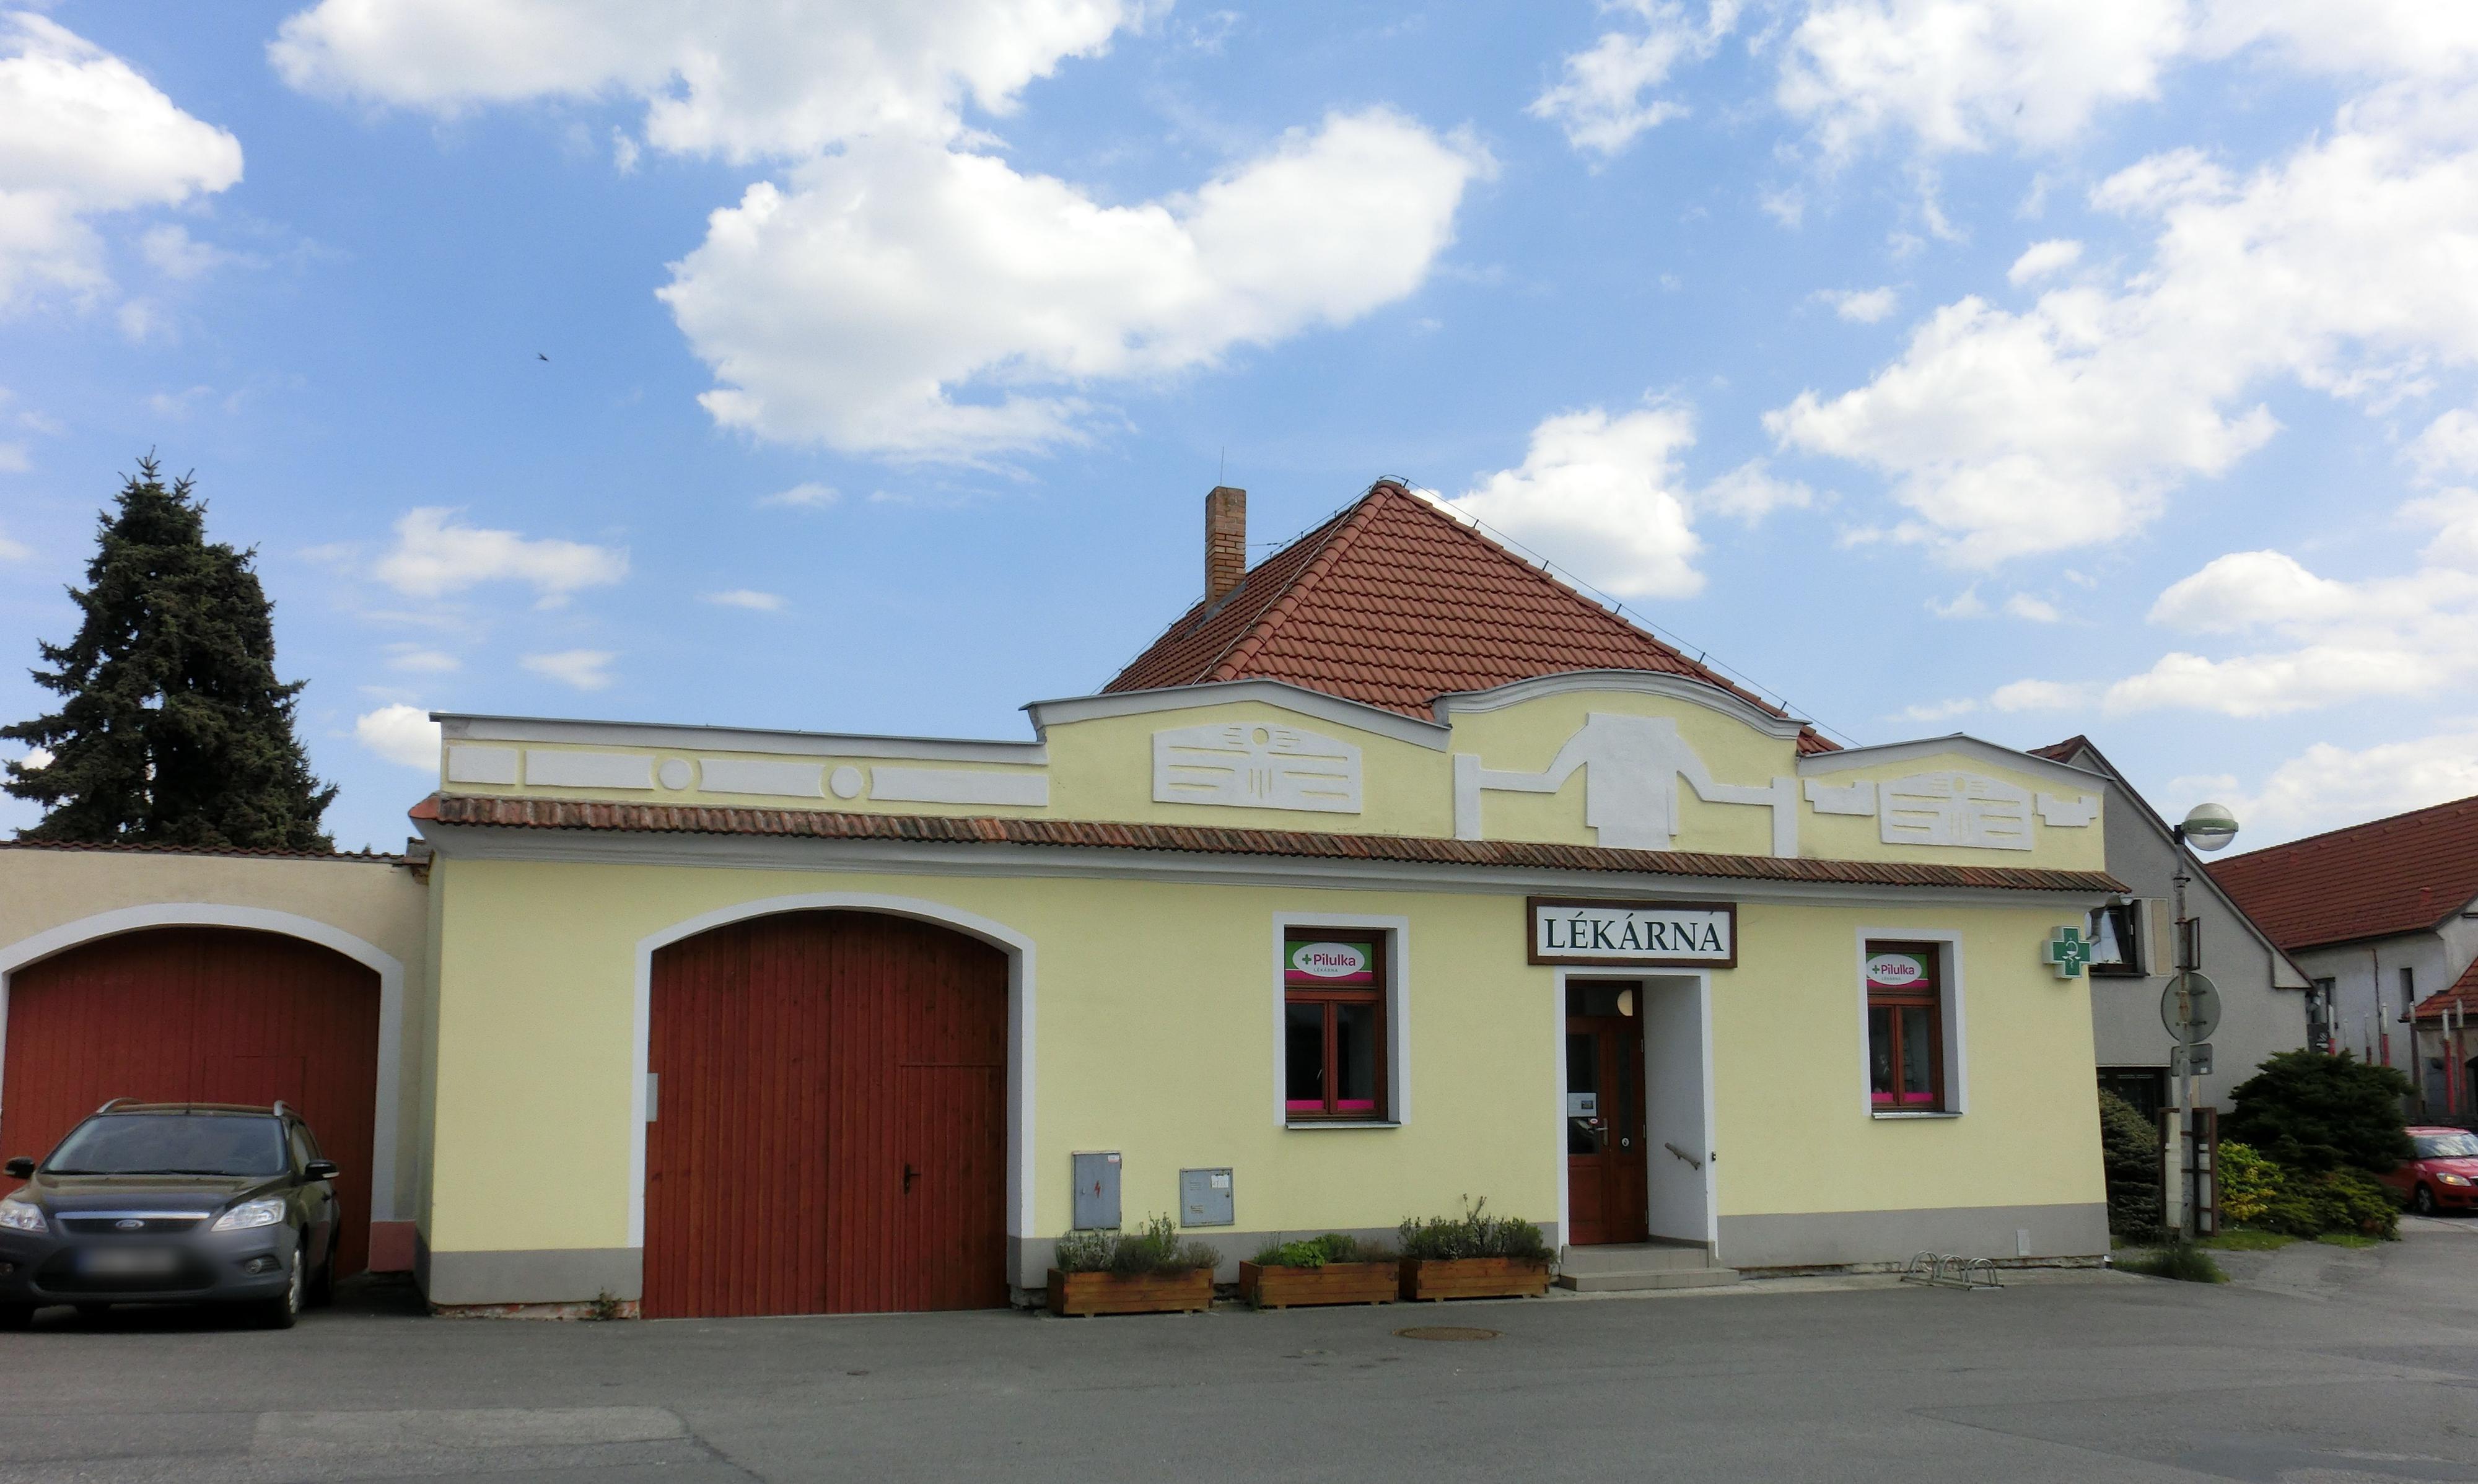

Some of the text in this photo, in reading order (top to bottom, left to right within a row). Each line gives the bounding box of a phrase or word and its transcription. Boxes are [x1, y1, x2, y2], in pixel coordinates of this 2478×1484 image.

[1544, 911, 1724, 952] LÉKÁRNA
[1313, 953, 1356, 966] Pilulka
[1881, 964, 1914, 975] Pilulka
